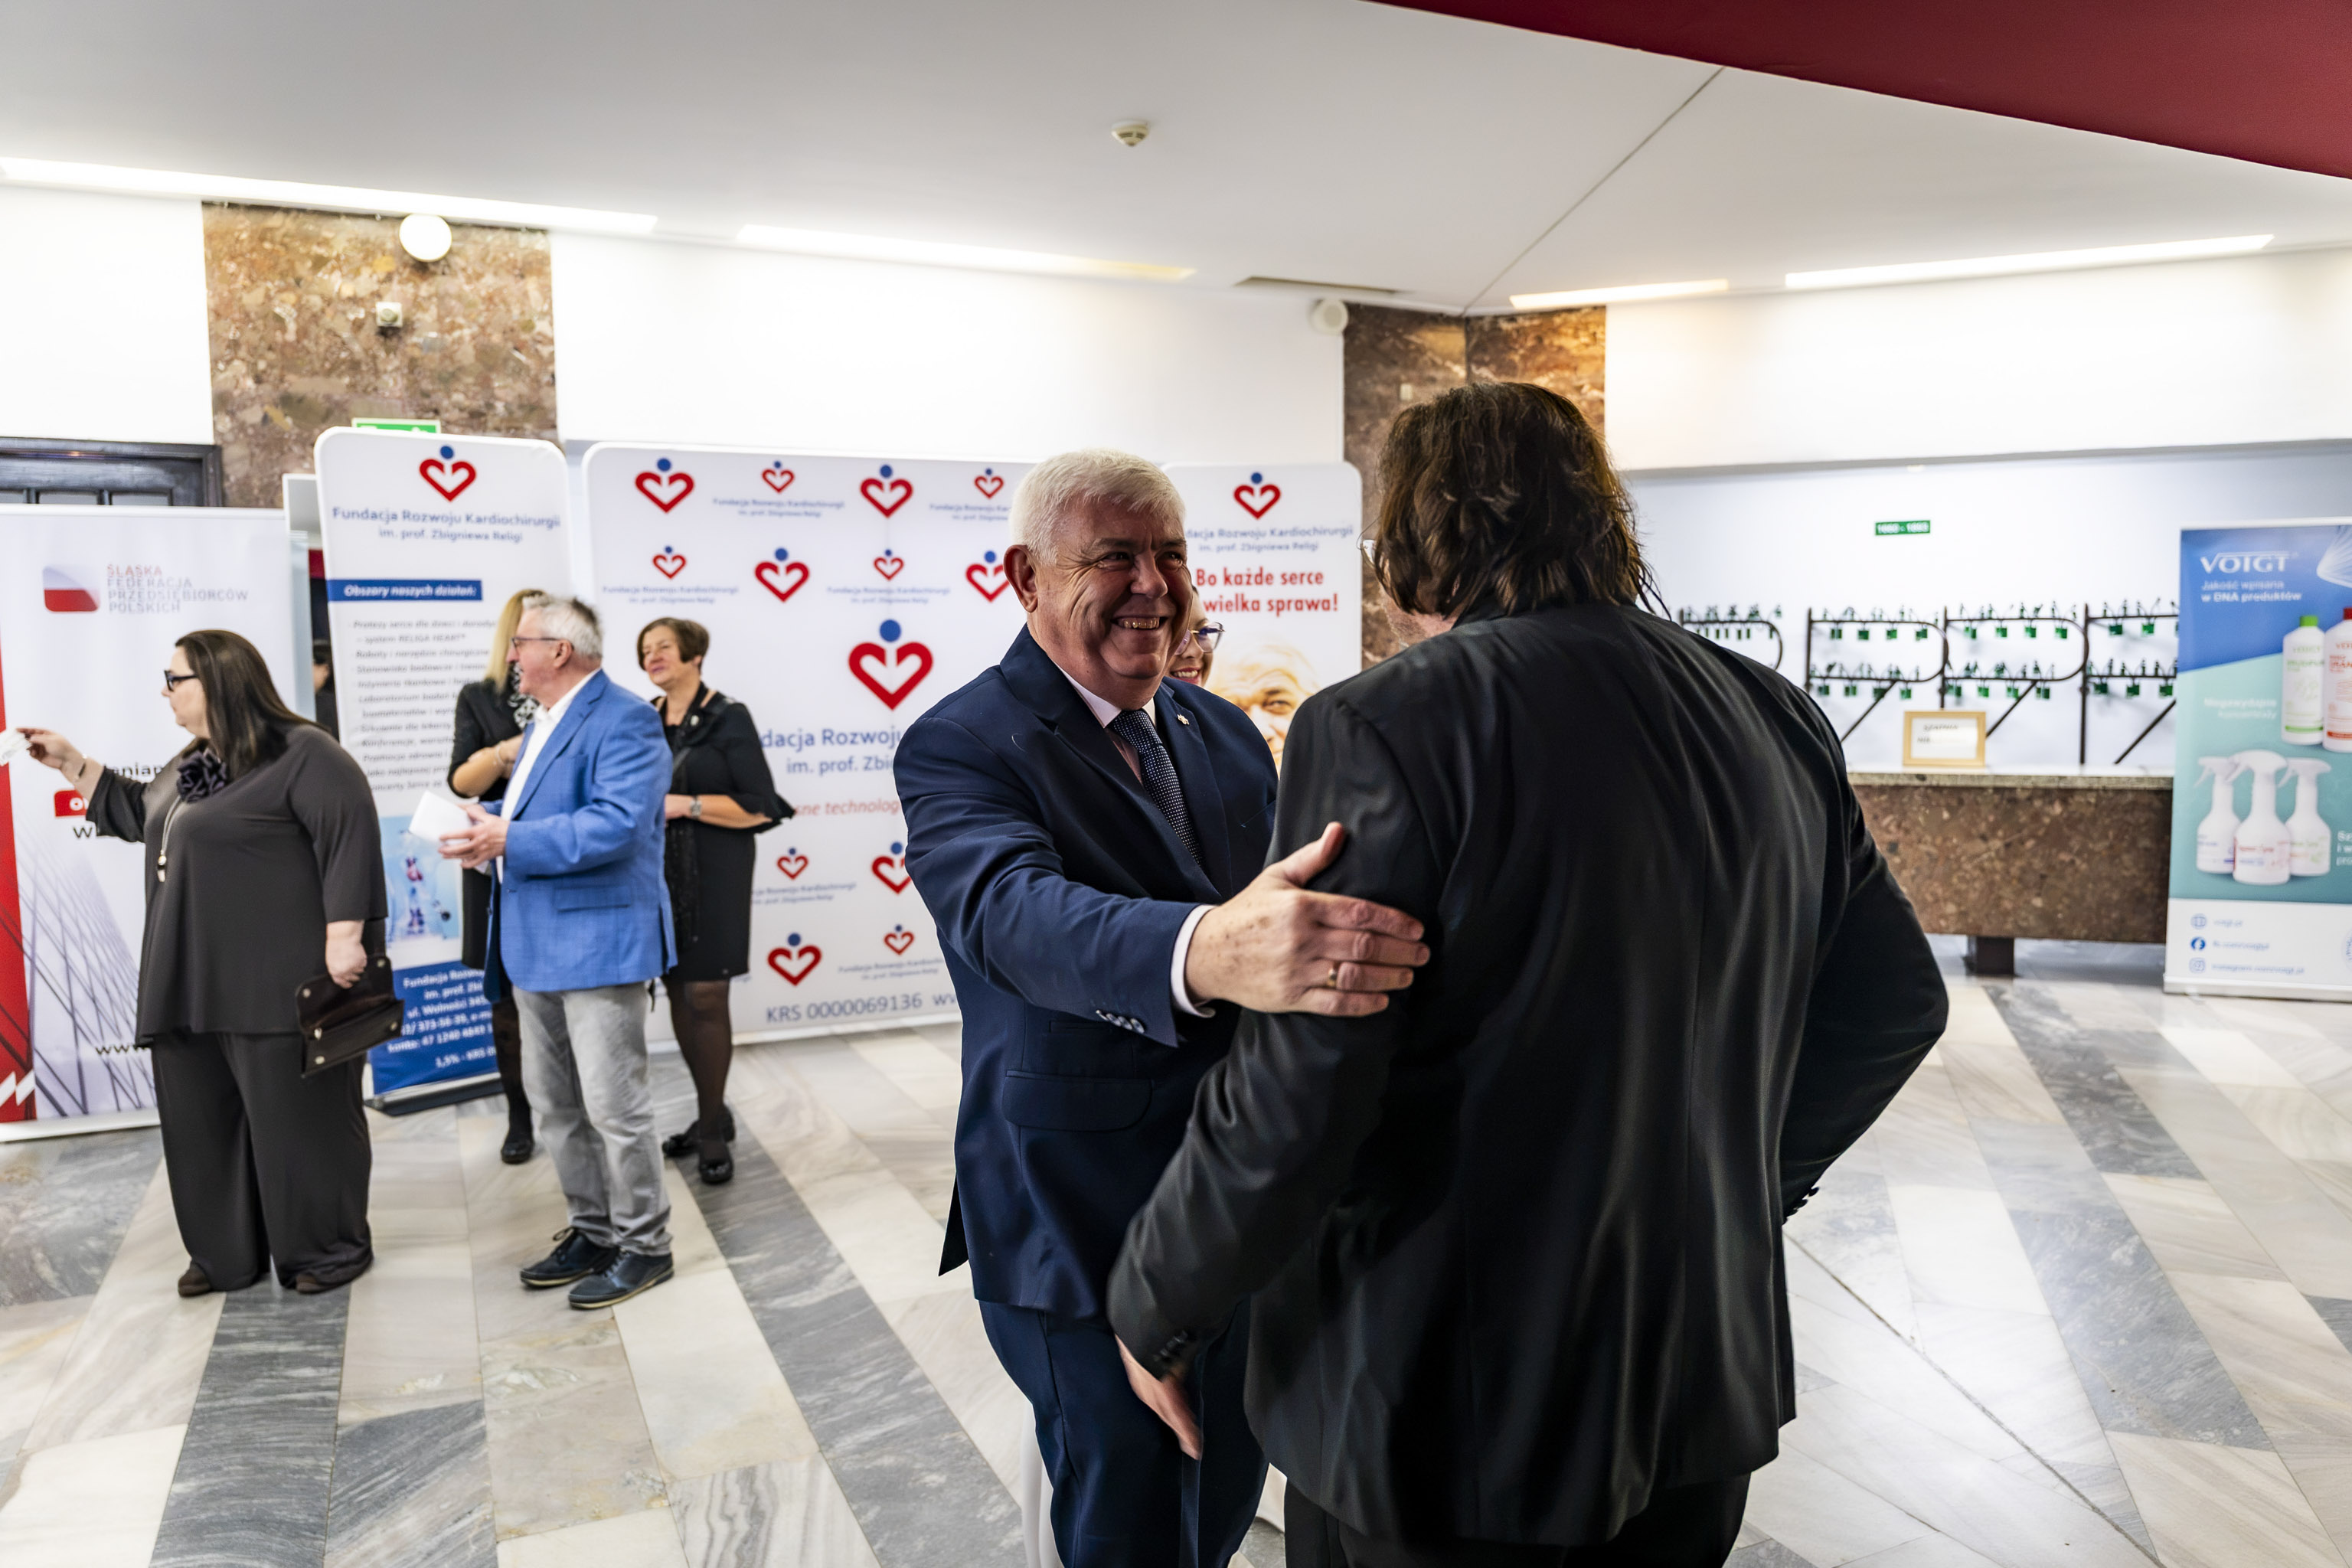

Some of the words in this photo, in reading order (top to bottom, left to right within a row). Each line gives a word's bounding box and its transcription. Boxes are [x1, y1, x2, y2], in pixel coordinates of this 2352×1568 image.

[332, 507, 398, 524] Fundacja
[402, 509, 461, 525] Rozwoju
[2200, 551, 2289, 573] VOIGT
[107, 577, 193, 588] FEDERACJA
[1196, 568, 1217, 586] Bo
[1224, 567, 1274, 586] każde
[1281, 570, 1323, 585] serce
[345, 584, 389, 598] Obszary
[392, 584, 433, 598] naszych
[2213, 592, 2239, 603] DNA
[109, 601, 180, 612] POLSKICH
[1204, 593, 1261, 612] wielka
[1267, 593, 1339, 617] sprawa!
[761, 728, 815, 752] dacja
[787, 757, 813, 774] im.
[819, 755, 858, 776] prof.
[403, 972, 449, 988] Fundacja
[766, 1004, 802, 1023] KRS
[806, 992, 923, 1020] 0000069136
